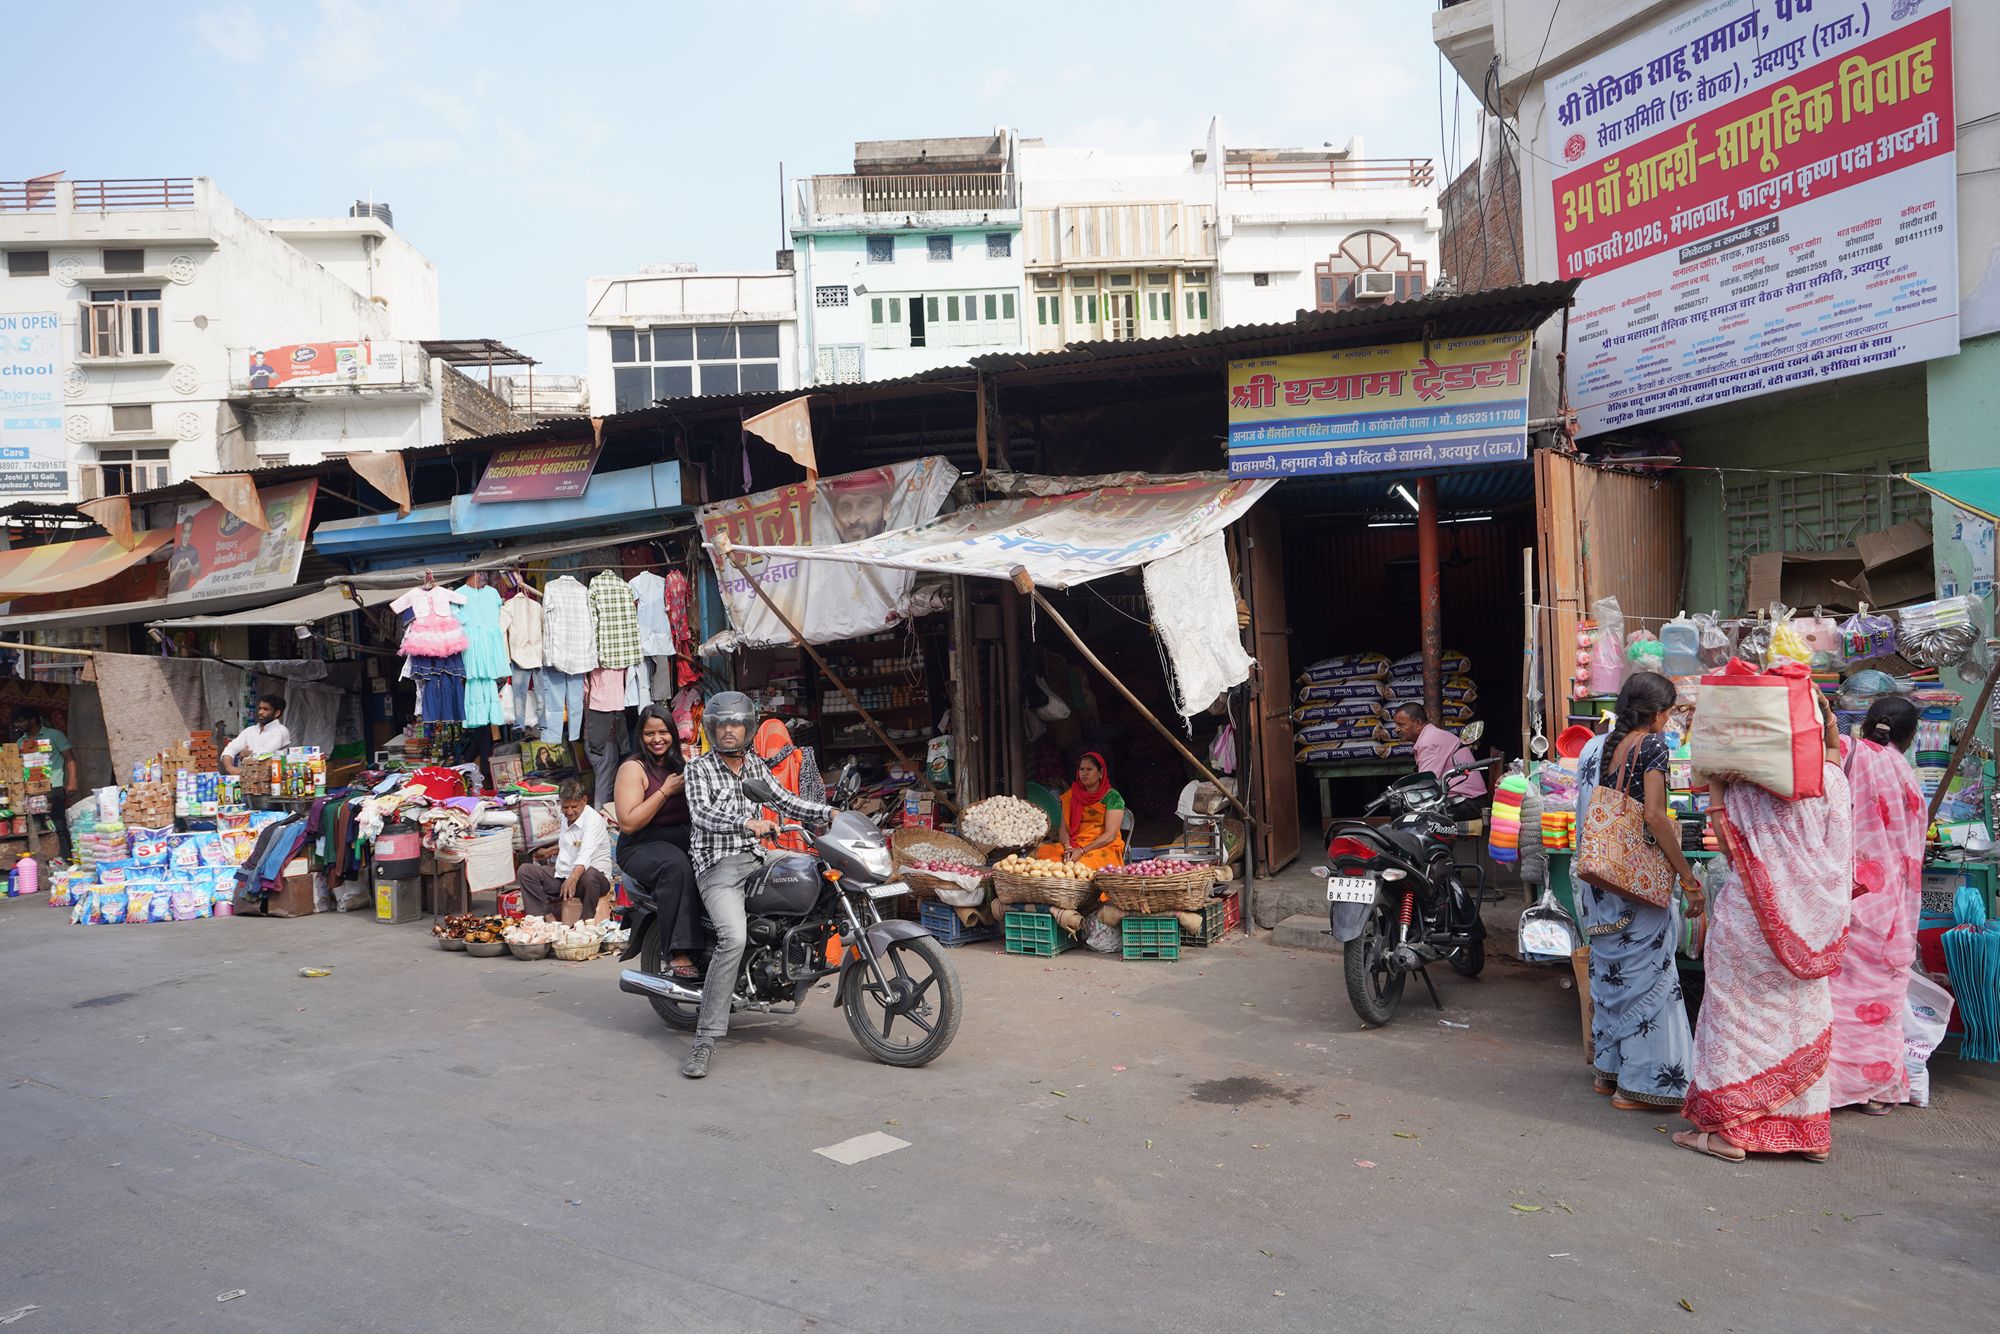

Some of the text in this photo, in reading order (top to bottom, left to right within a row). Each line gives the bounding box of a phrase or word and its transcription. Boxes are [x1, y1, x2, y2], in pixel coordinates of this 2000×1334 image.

[1558, 92, 1582, 127] श्री
[1582, 66, 1643, 117] तैलिक
[1647, 45, 1692, 86] साहू
[1691, 9, 1770, 65] समाज,
[1597, 121, 1622, 147] सेवा
[1624, 97, 1665, 138] समिति
[1696, 62, 1749, 104] बैठक),
[1751, 36, 1807, 80] उदयपुर
[1812, 2, 1871, 57] (राज.)
[1839, 37, 1938, 123] विवाह
[1566, 112, 1939, 275] 10 फरवरी 2026, मंगलवार, फाल्गुन कृष्ण पक्ष अष्टमी
[1602, 338, 1612, 350] श्री
[1627, 324, 1660, 342] महासभा
[1660, 315, 1690, 334] तैलिक
[1689, 309, 1710, 324] साहू
[1708, 301, 1740, 319] समाज
[1758, 287, 1785, 304] बैठक
[1785, 279, 1808, 296] सेवा
[1808, 267, 1848, 289] समिति,
[1850, 255, 1892, 277] उदयपुर
[21, 316, 58, 330] OPEN
[1230, 348, 1527, 409] श्री श्याम ट्रेडर्स
[1233, 430, 1257, 443] अनाज
[1256, 427, 1265, 441] के
[1330, 419, 1360, 435] व्यापारी
[1367, 415, 1408, 432] कांकरोली
[1408, 416, 1430, 429] वाला
[1439, 411, 1454, 426] मो.
[3, 449, 24, 457] Care
[496, 450, 517, 463] SHIV
[543, 444, 583, 459] HOSIERY
[583, 443, 593, 455] &
[1231, 438, 1522, 473] धानमण्डी, हनुमान जी के मन्दिर के सामने, उदयपुर (राज.)
[4, 473, 23, 481] Joshi
[485, 459, 591, 479] READYMADE GARMENTS
[33, 480, 62, 489] Udaipur
[772, 876, 798, 884] HONDA
[1346, 892, 1374, 902] 7717
